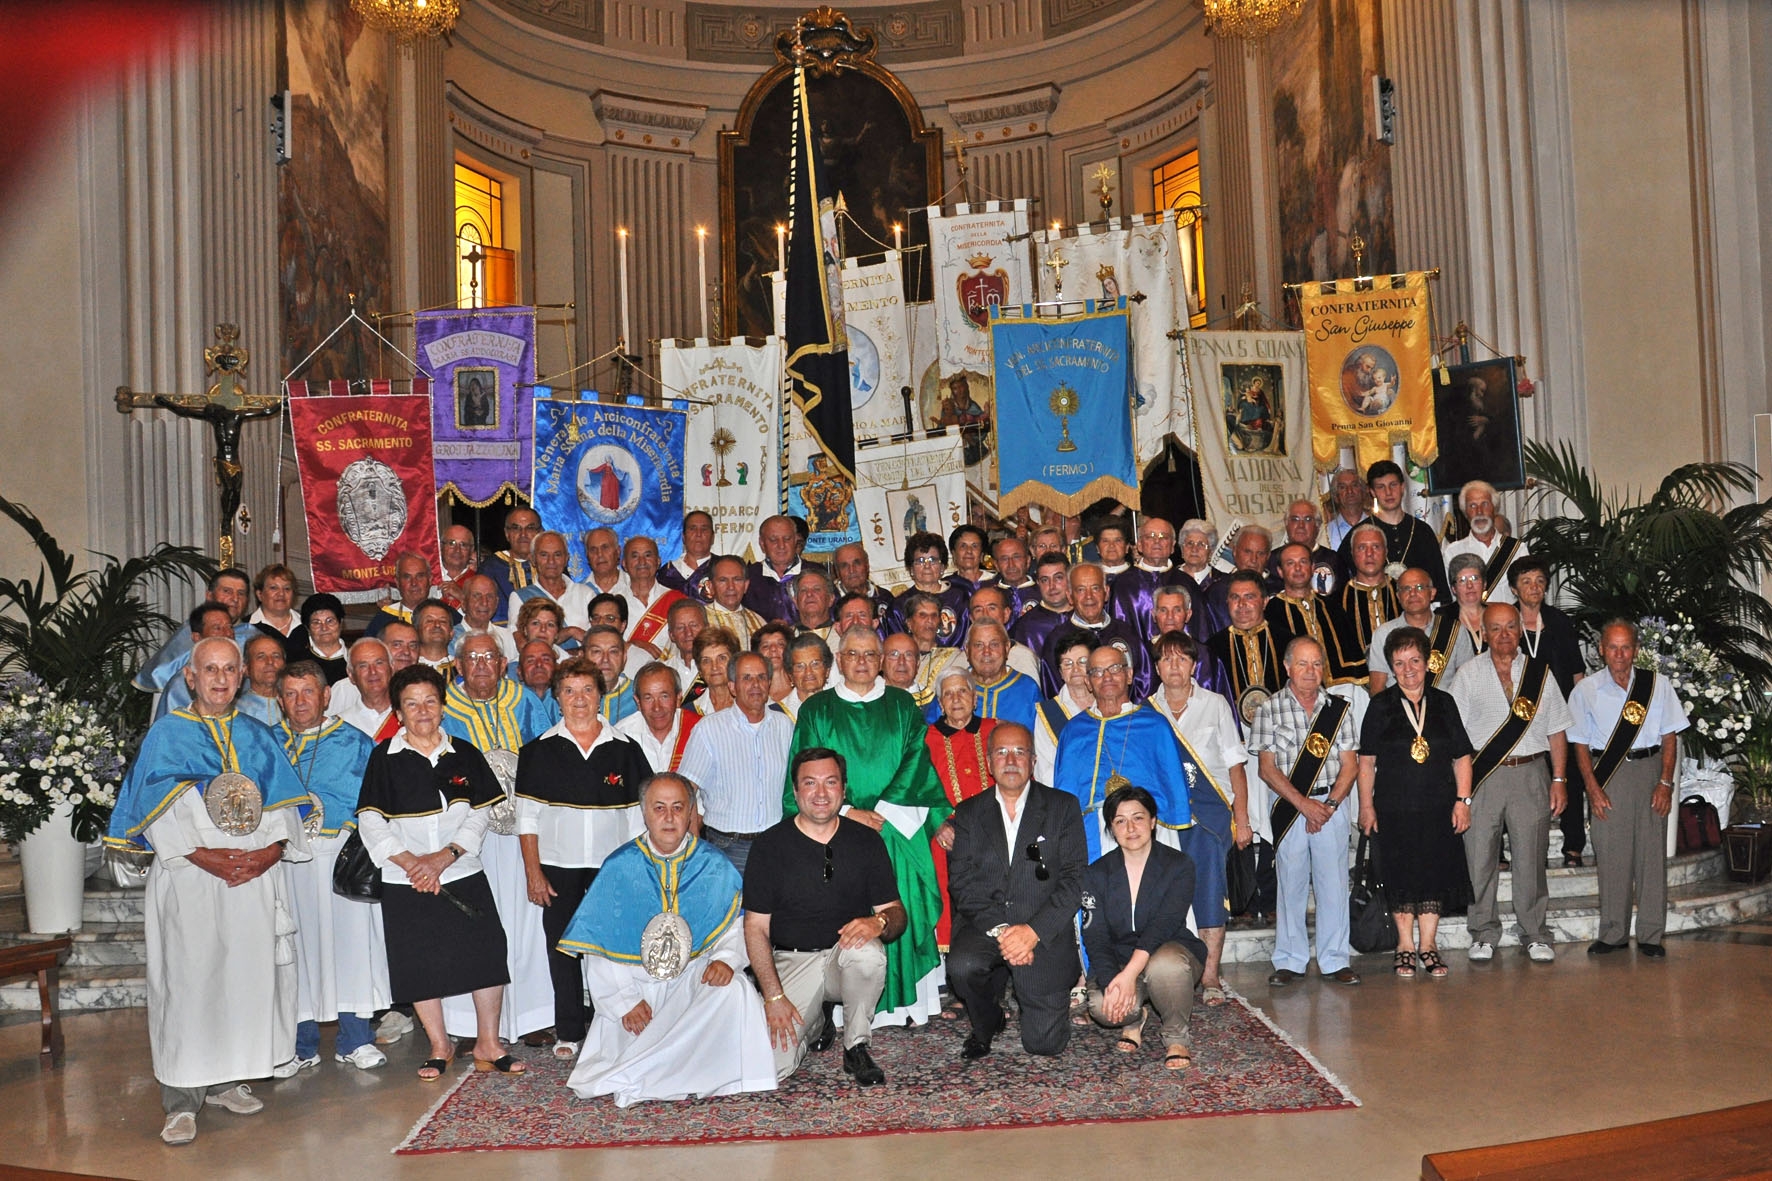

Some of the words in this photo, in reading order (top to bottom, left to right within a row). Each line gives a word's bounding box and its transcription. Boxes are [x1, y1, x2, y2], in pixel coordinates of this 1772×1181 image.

[951, 220, 1005, 232] CONFRATERNITA
[957, 240, 1003, 250] MISERICORDIA
[842, 272, 895, 290] ERNITA
[844, 295, 898, 312] MENTO
[1311, 297, 1417, 317] CONFRATERNITA
[1315, 318, 1351, 342] San
[1350, 314, 1416, 343] Giuseppe
[317, 410, 408, 435] CONFRATERNITA
[1376, 418, 1412, 427] Giovanni
[316, 440, 336, 452] SS.
[338, 437, 413, 450] SACRAMENTO
[546, 456, 566, 494] Maria
[597, 424, 627, 438] della
[629, 430, 673, 503] Misericordia
[1224, 458, 1303, 482] MADONNA
[714, 522, 754, 534] FERMO
[342, 567, 380, 580] MONTE
